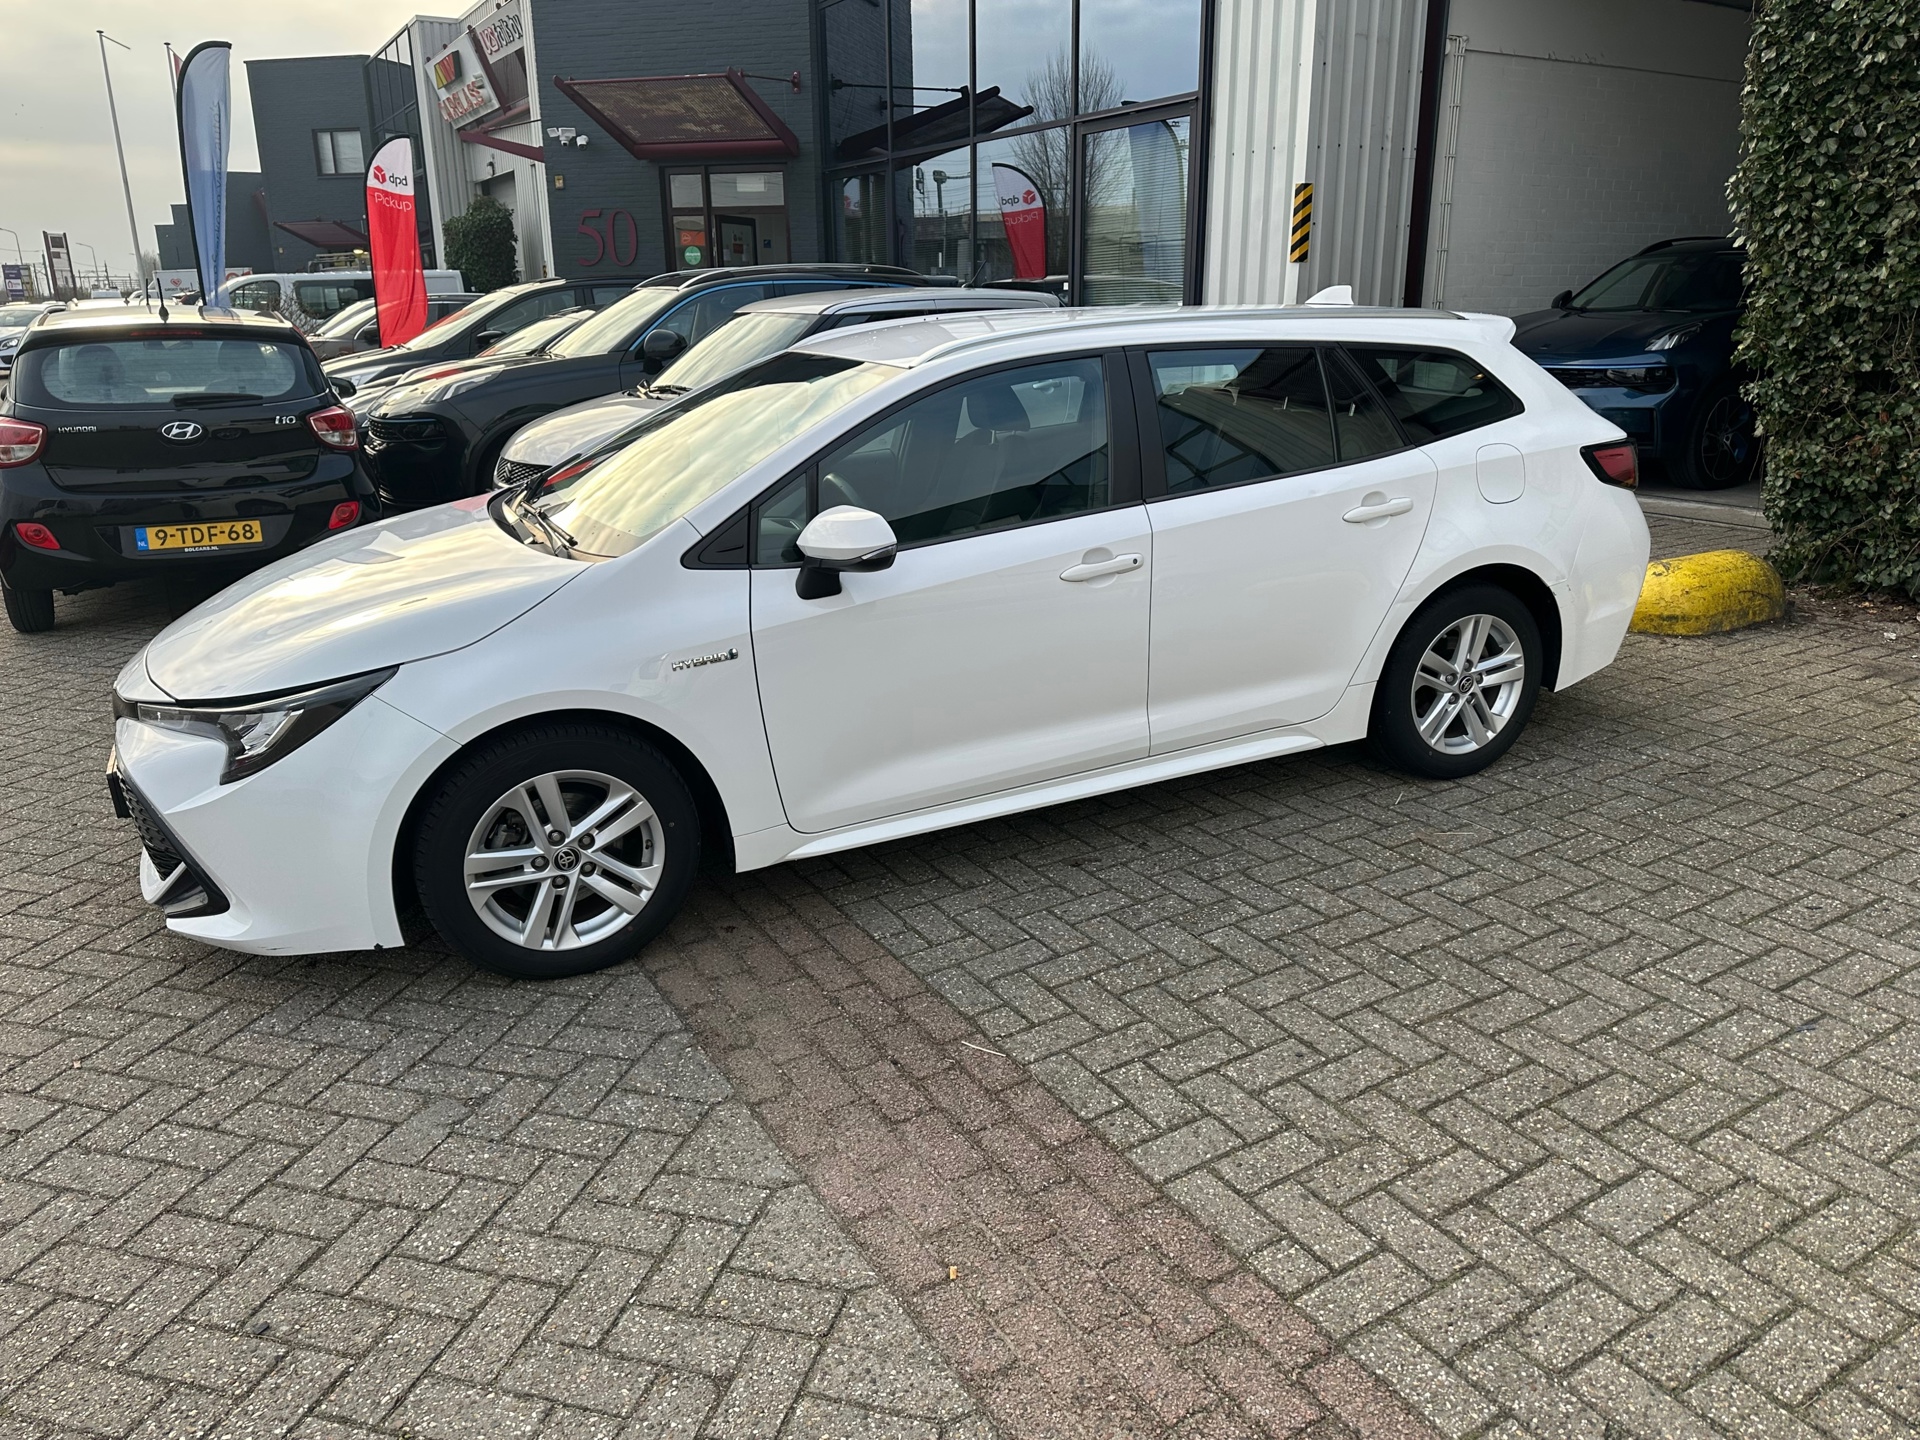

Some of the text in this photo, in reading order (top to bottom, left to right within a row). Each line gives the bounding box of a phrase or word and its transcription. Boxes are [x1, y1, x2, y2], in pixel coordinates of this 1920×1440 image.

[437, 81, 485, 122] CARGLASS
[388, 173, 408, 187] dpd
[374, 192, 412, 213] Pickup
[577, 208, 638, 267] 50
[58, 425, 97, 434] HYUNDAI
[275, 415, 296, 425] i10
[155, 523, 255, 546] 9-TDF-68
[671, 651, 729, 672] HYBRID
